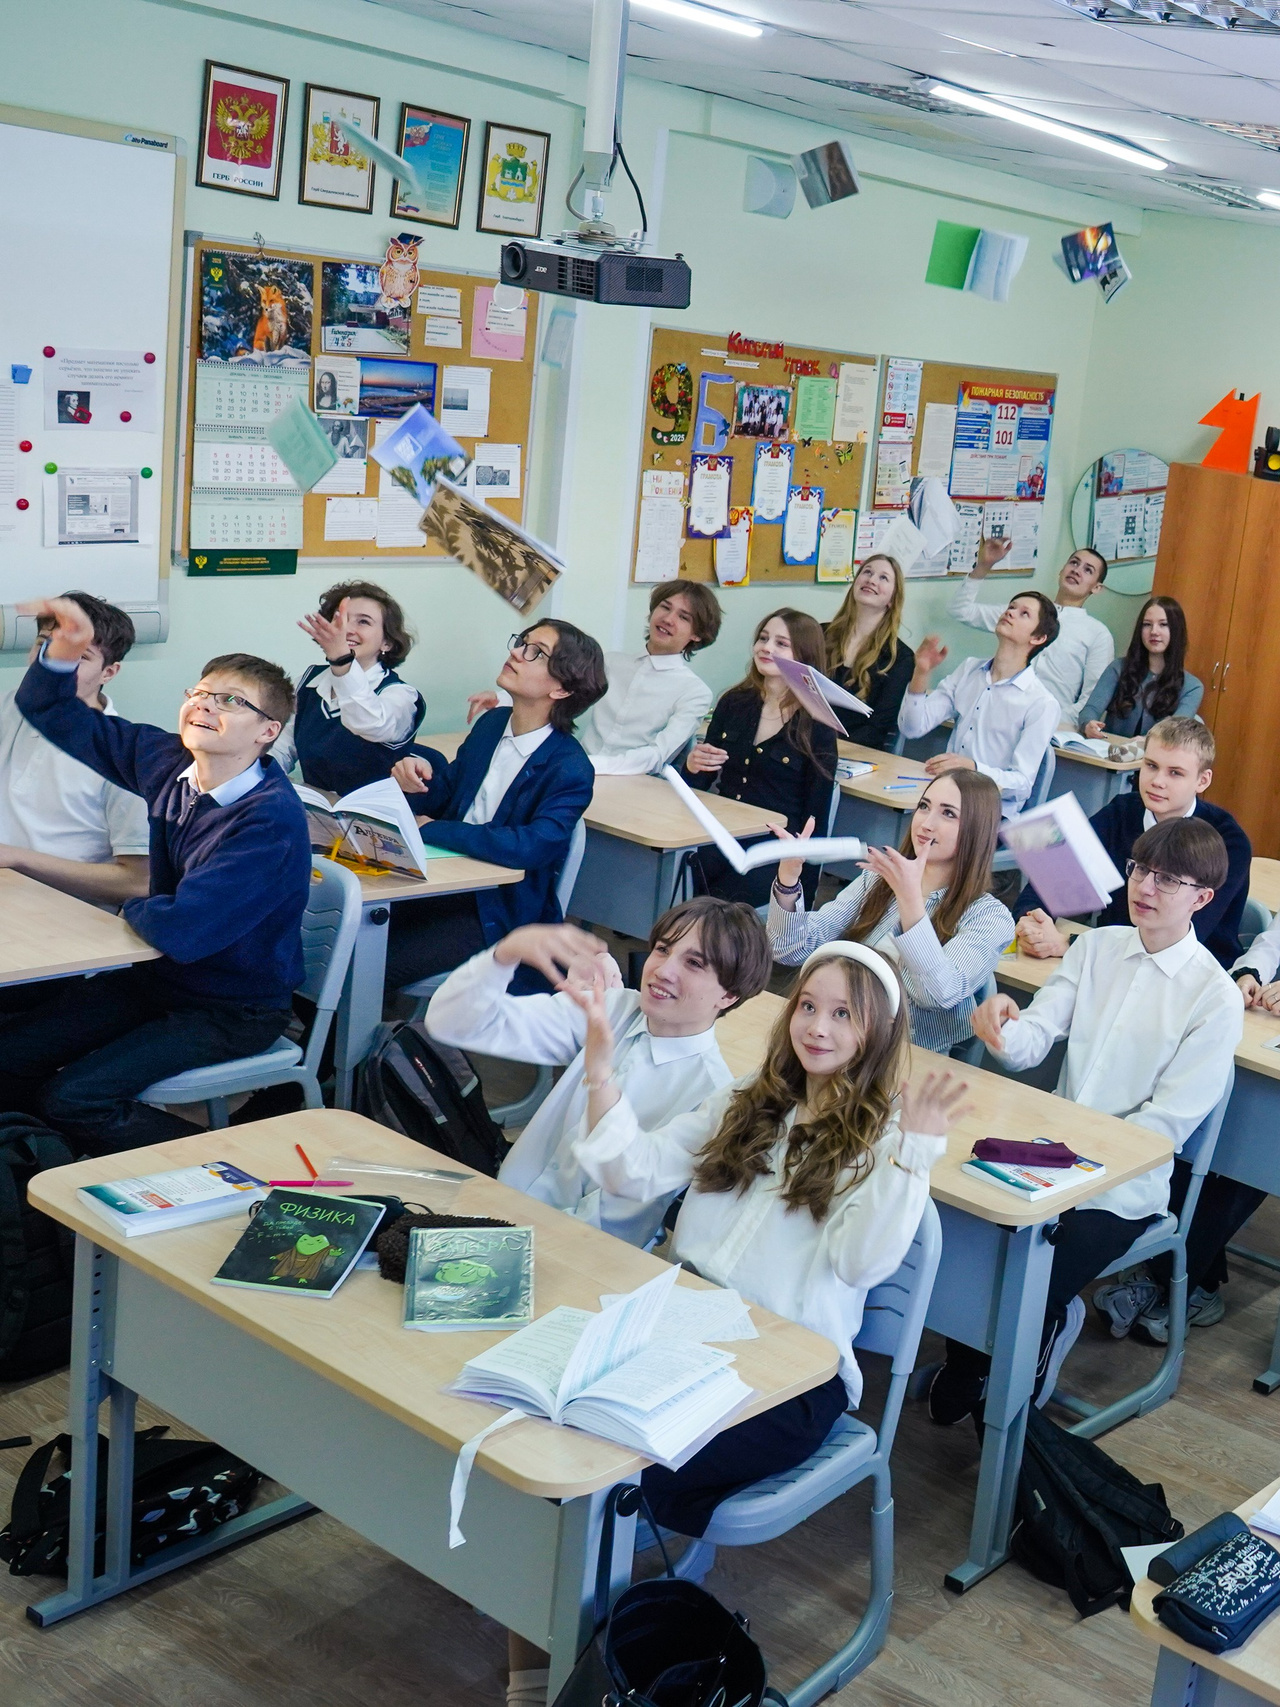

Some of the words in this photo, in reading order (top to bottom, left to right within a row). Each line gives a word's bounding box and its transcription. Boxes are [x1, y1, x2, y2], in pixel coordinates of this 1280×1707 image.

[140, 138, 168, 148] Panaboard
[212, 173, 230, 181] ГЕРБ
[234, 177, 263, 187] РОССИИ
[971, 386, 1003, 398] ПОЖАРНАЯ
[1004, 389, 1044, 401] БЕЗОПАСНОСТЬ
[651, 363, 693, 445] 9
[692, 372, 734, 454] Б
[997, 405, 1017, 420] 112
[670, 433, 685, 442] 2025
[995, 430, 1013, 445] 101
[280, 1202, 356, 1226] ФИЗИКА
